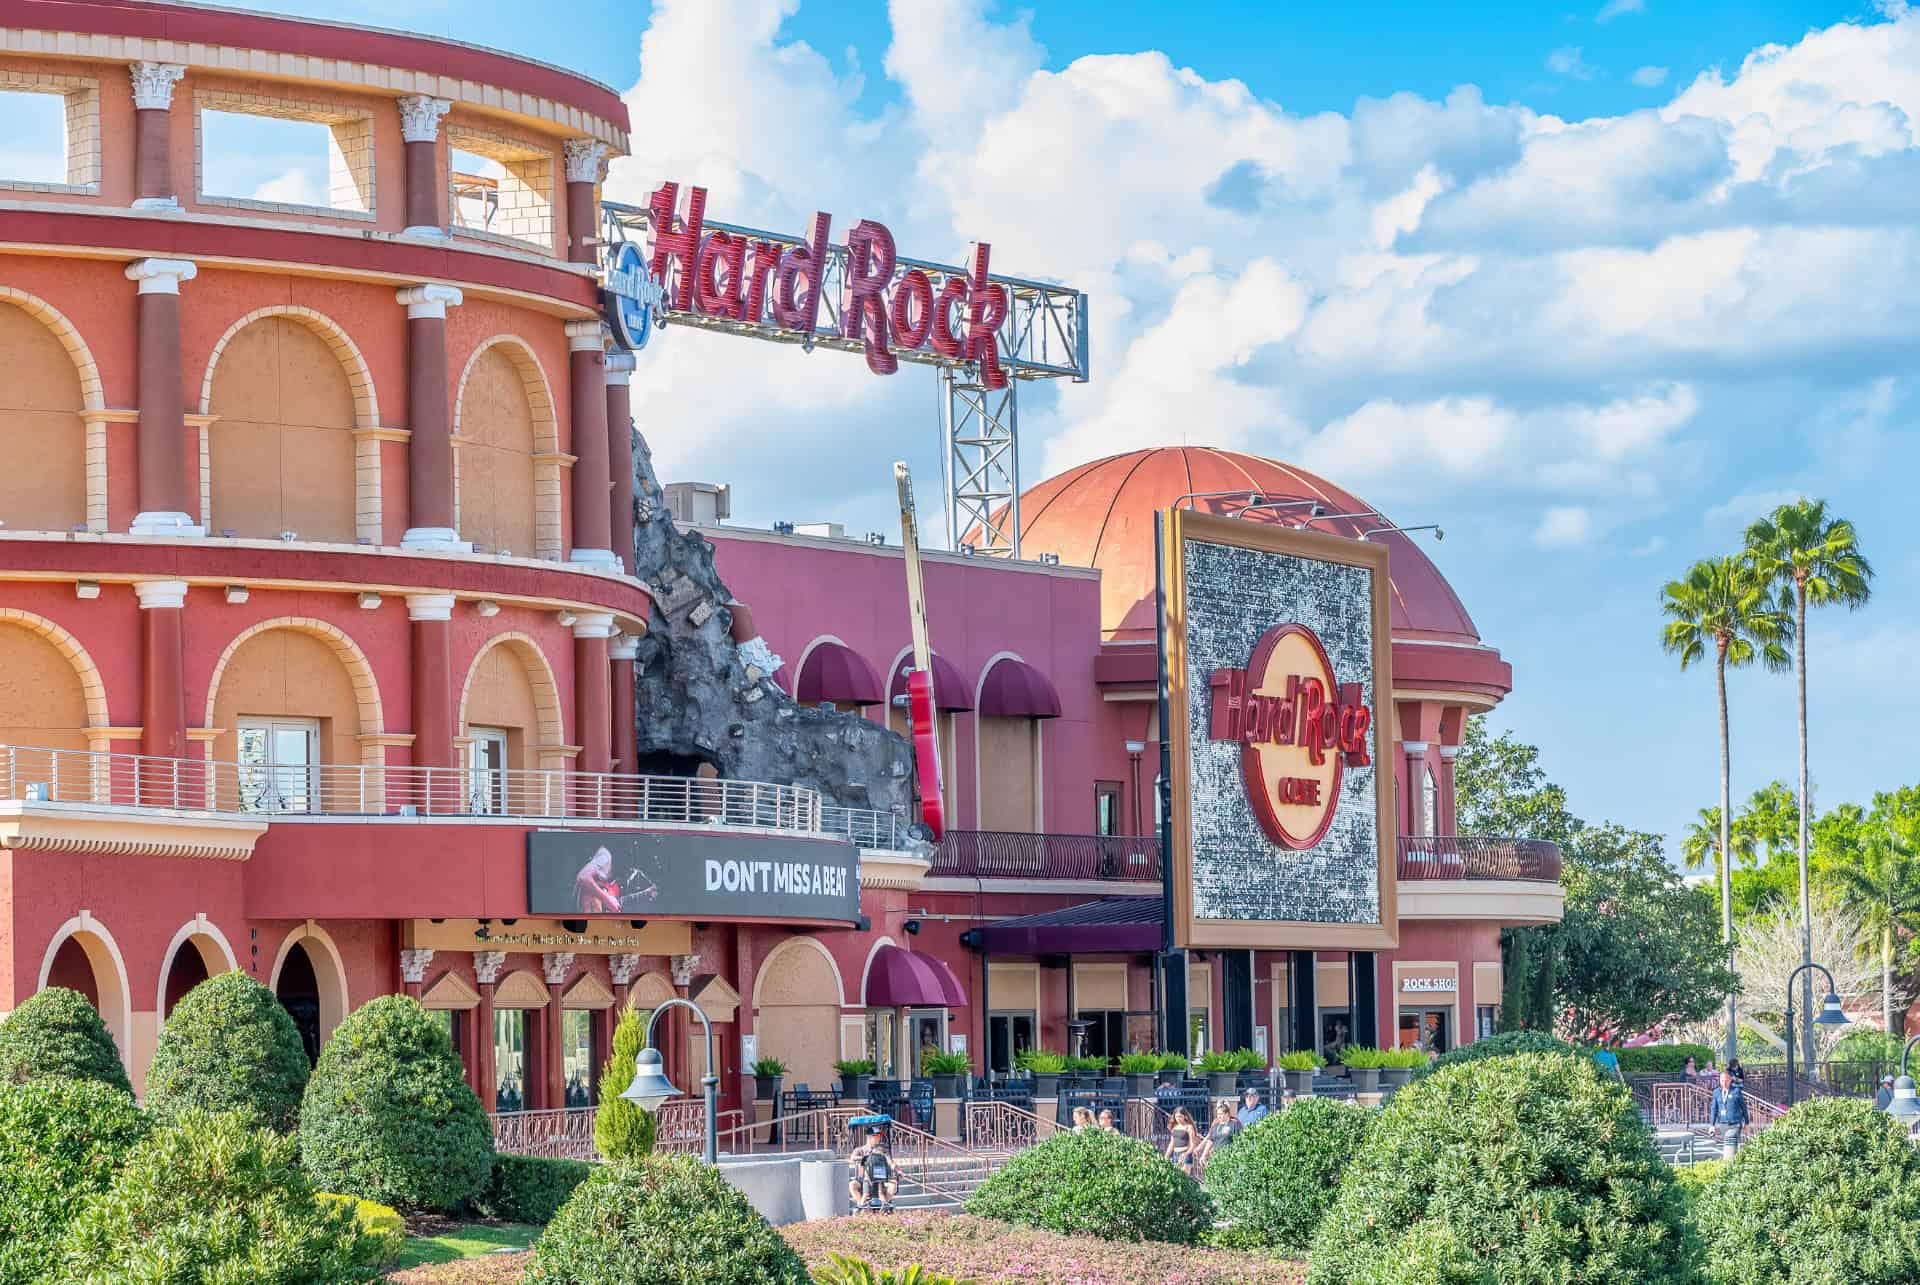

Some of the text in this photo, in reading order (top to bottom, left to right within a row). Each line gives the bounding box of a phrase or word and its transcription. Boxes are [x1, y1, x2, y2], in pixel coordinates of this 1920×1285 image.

[646, 181, 1008, 390] Hard Rock
[1210, 668, 1371, 767] Hard Rock
[705, 859, 847, 897] DON'T MISS A BEAT
[1403, 978, 1431, 992] ROCK
